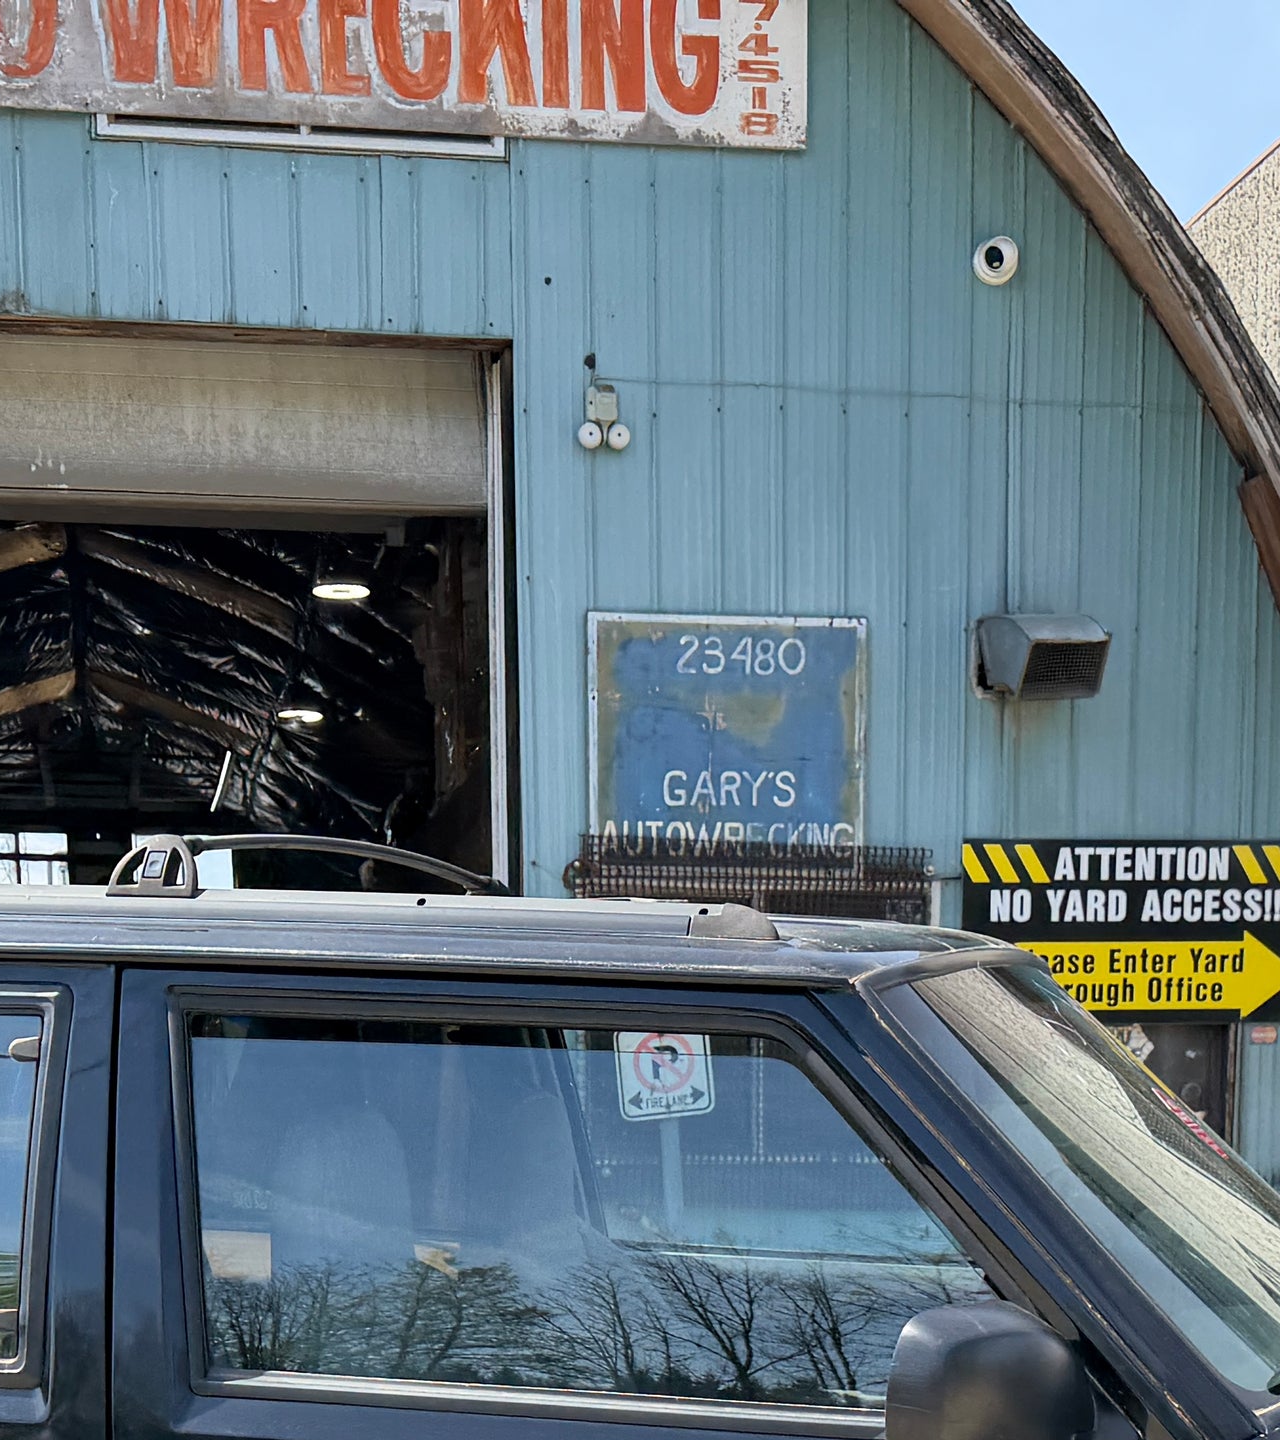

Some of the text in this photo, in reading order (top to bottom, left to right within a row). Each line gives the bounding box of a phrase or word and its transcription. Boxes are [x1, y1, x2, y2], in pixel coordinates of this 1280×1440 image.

[676, 633, 807, 676] 23480
[662, 769, 797, 808] GARY'S
[1053, 846, 1231, 882] ATTENTION
[989, 888, 1033, 923] NO
[1046, 888, 1127, 923] YARD
[1108, 948, 1177, 975] Enter
[1189, 948, 1245, 975] Yard
[1147, 976, 1224, 1003] Office
